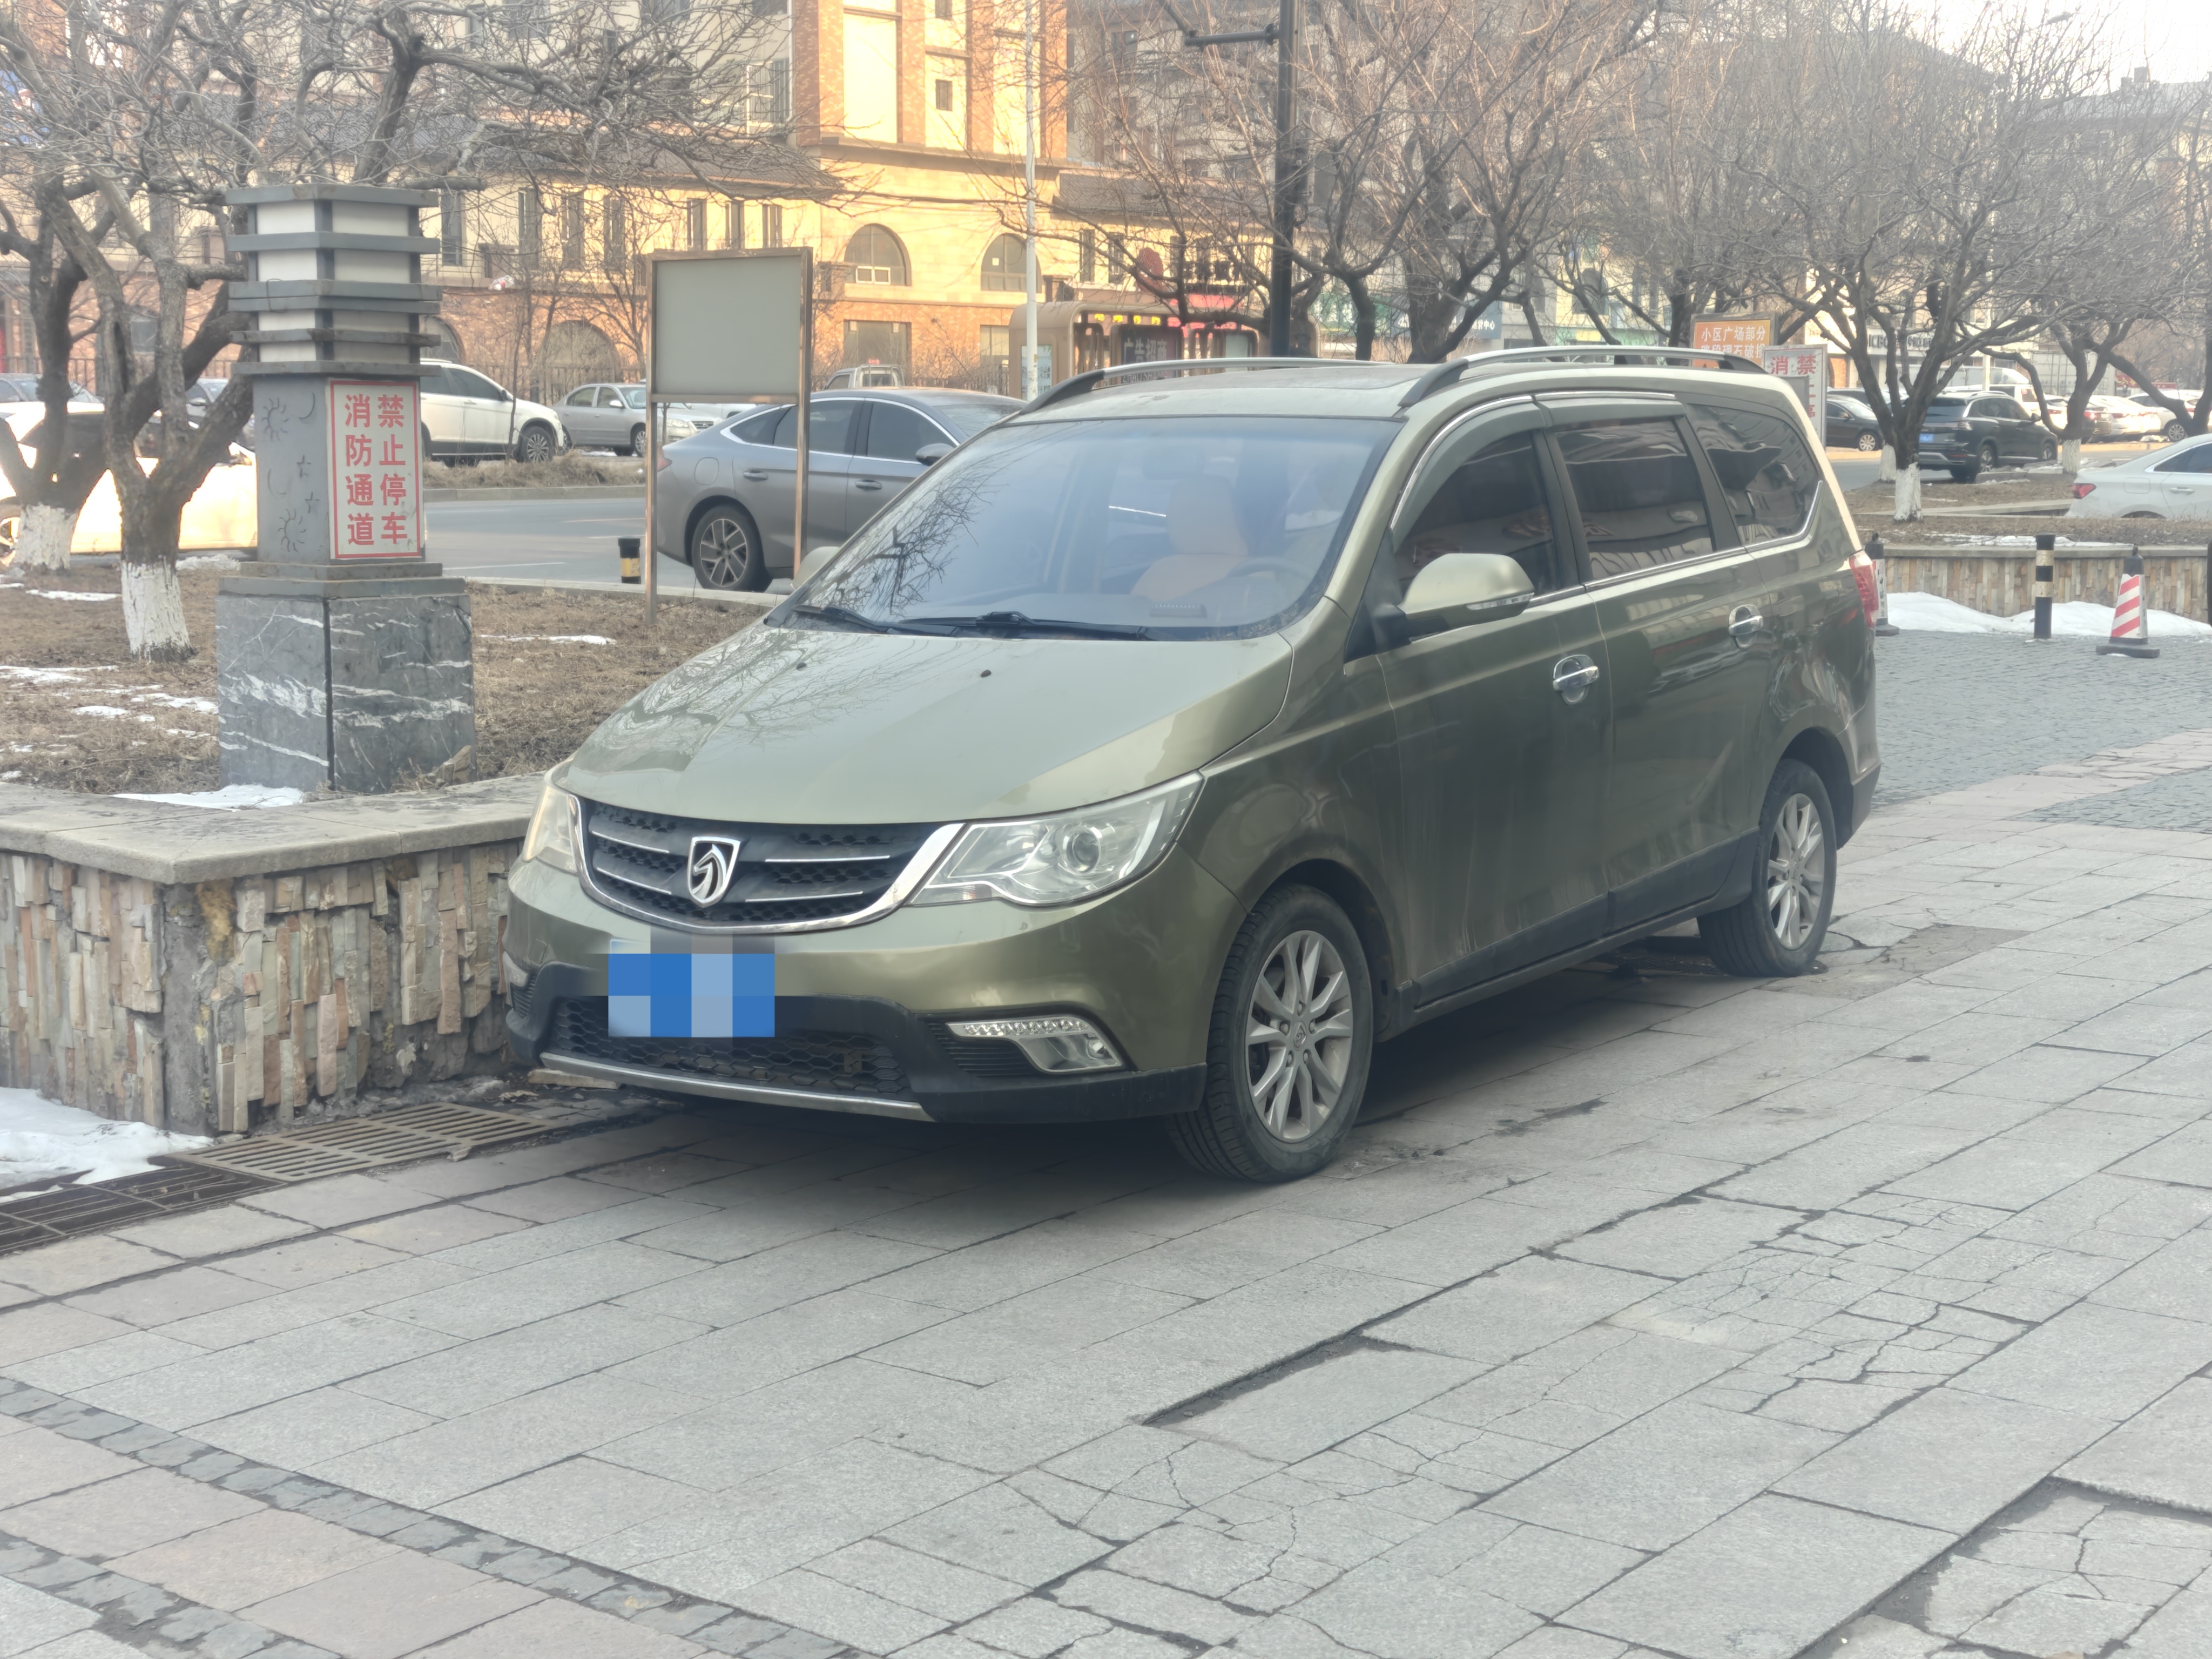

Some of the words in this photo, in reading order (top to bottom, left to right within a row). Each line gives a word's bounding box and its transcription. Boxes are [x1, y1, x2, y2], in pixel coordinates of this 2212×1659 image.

[1701, 326, 1766, 342] 小区广场部分
[345, 394, 375, 545] 消防通道
[377, 394, 408, 544] 禁止停车
